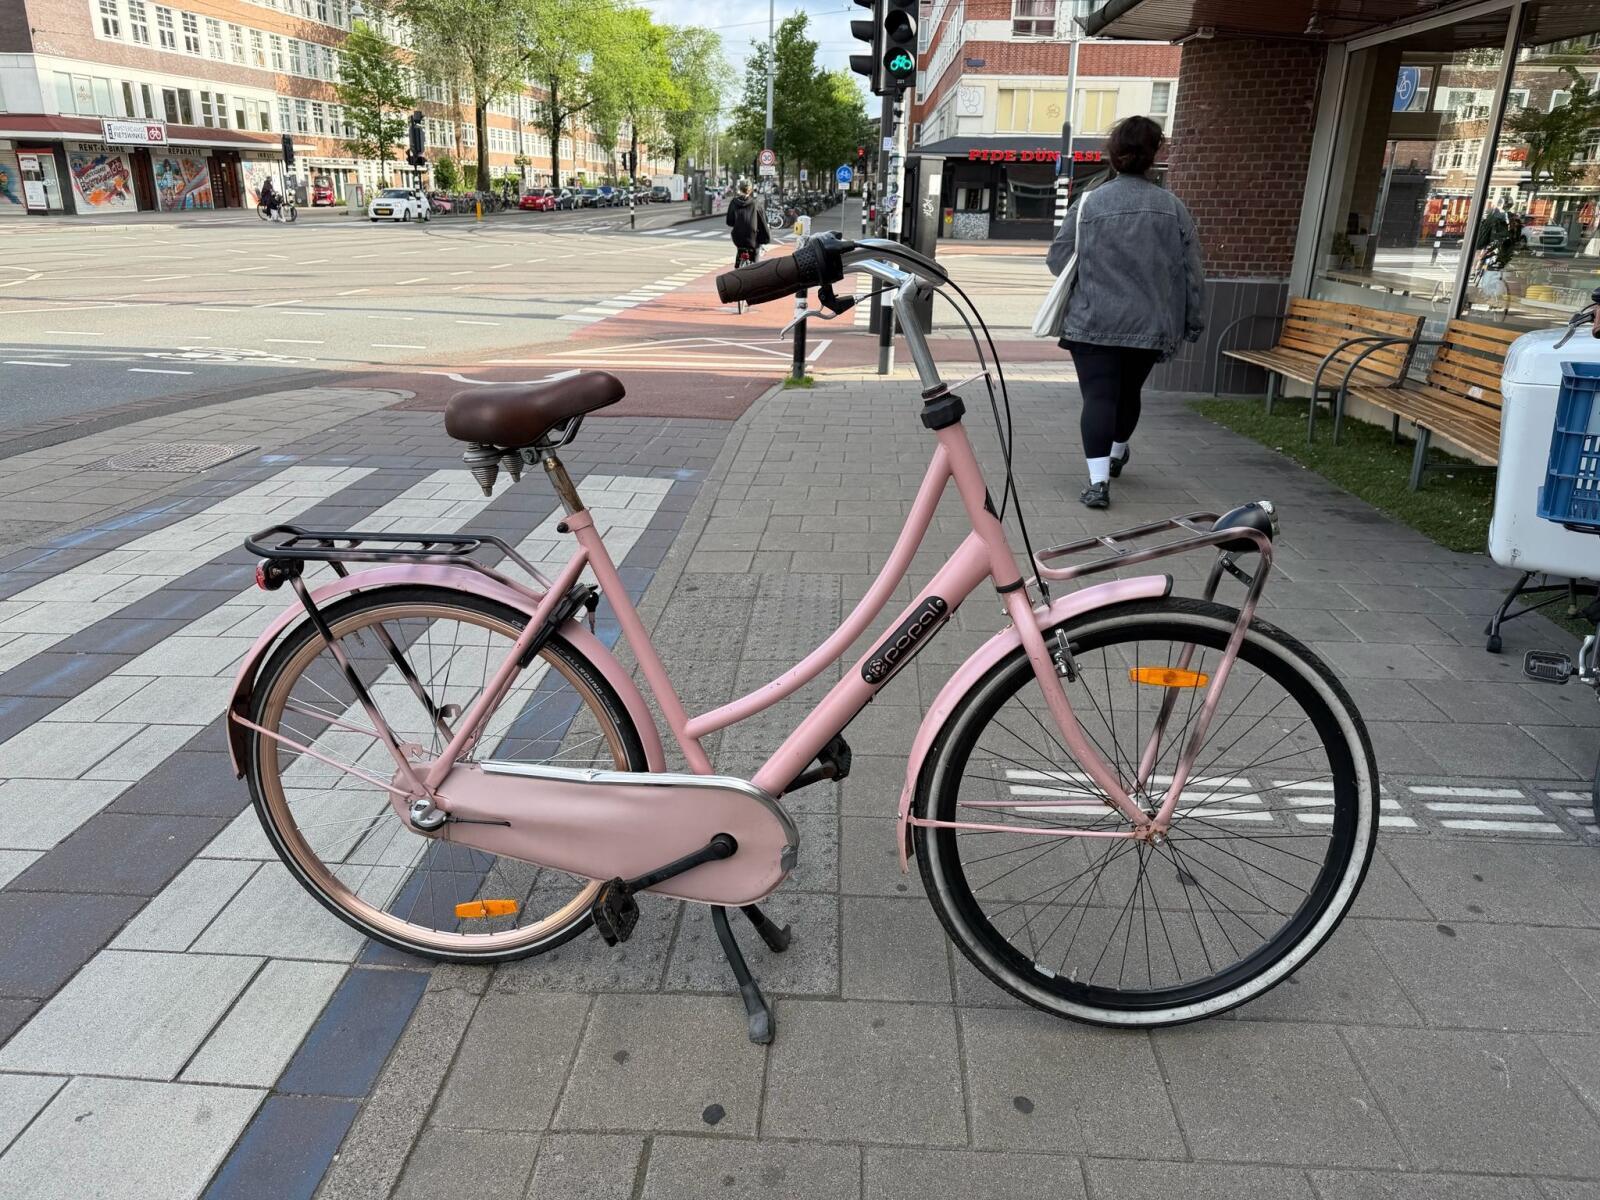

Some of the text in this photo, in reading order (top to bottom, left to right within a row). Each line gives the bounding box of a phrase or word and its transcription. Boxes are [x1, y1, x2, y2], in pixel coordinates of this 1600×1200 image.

[78, 143, 126, 153] RENT-A-BIKE
[968, 147, 1102, 162] PIDE DÜNASI
[884, 603, 940, 664] popal
[565, 655, 603, 695] ALLROUND
